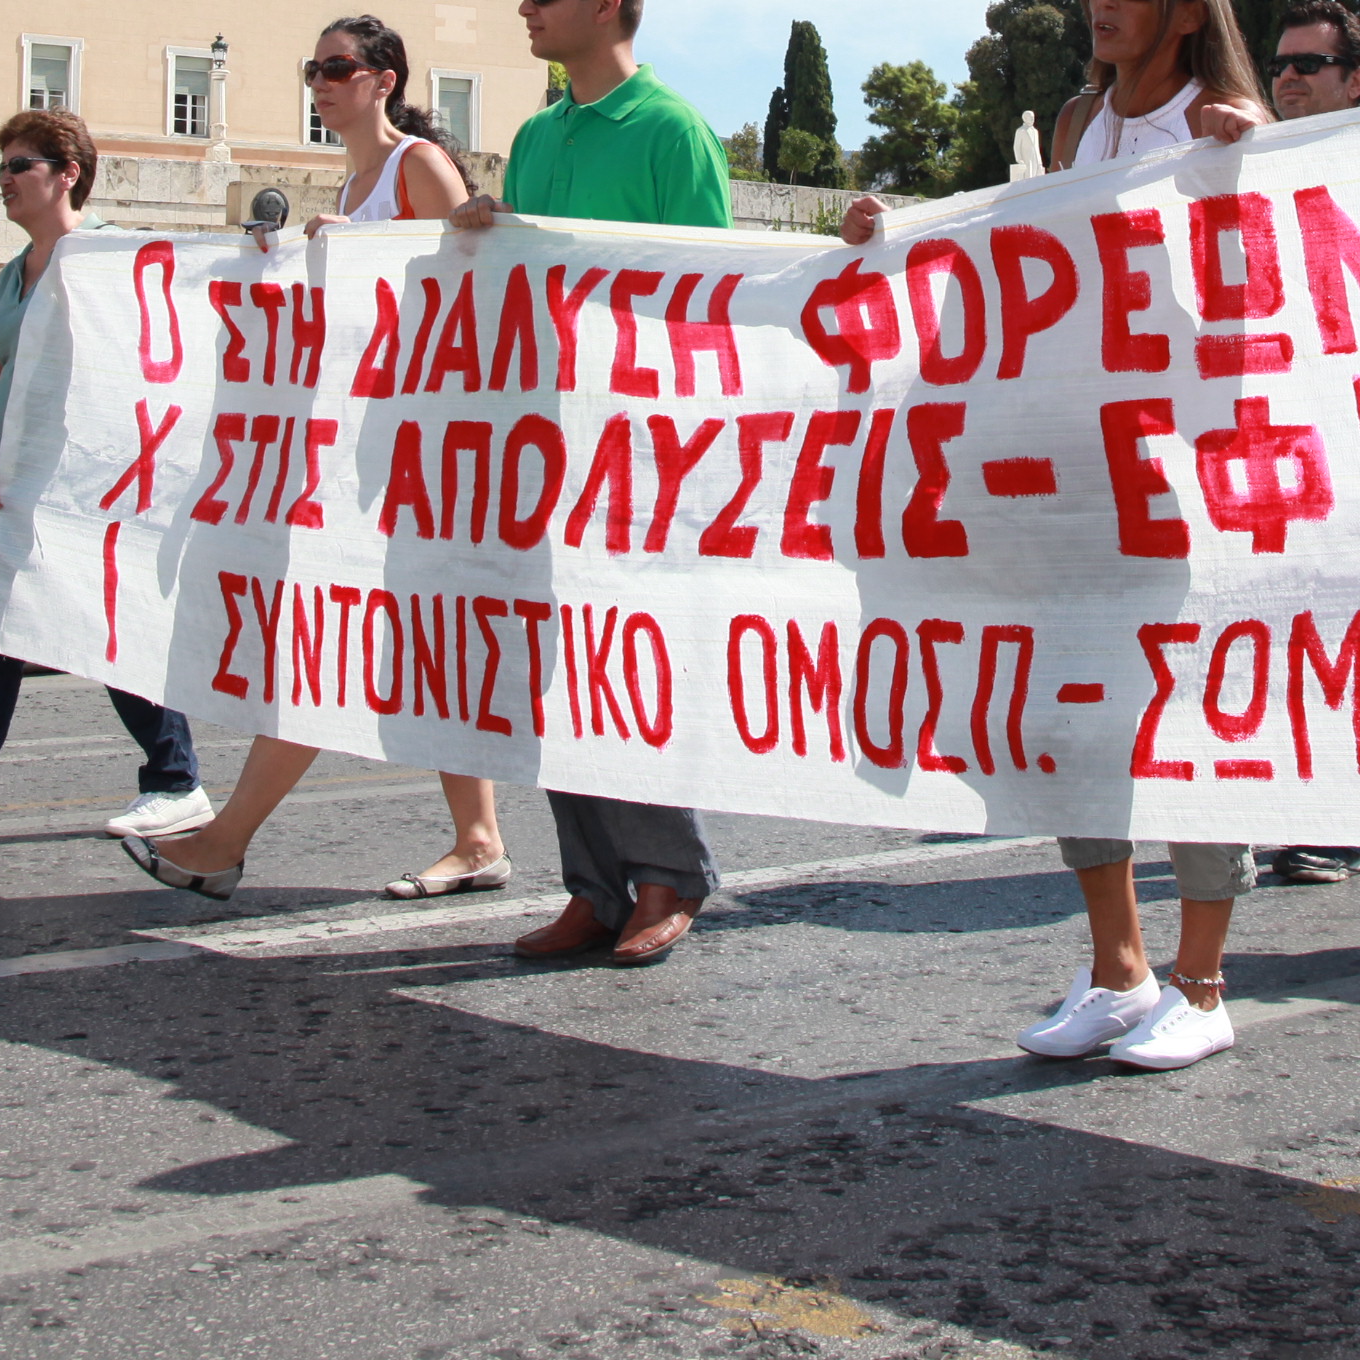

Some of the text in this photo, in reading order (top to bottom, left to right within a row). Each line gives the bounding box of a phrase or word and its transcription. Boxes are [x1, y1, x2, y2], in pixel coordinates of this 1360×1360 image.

[209, 281, 325, 388] ΣΤΗ
[351, 264, 743, 399] ΔΙΑΛΥΣΗ
[191, 413, 338, 528] ΣΤΙΣ
[212, 571, 672, 749] ΣΥΝΤΟΝΙΣΤΙΚΟ
